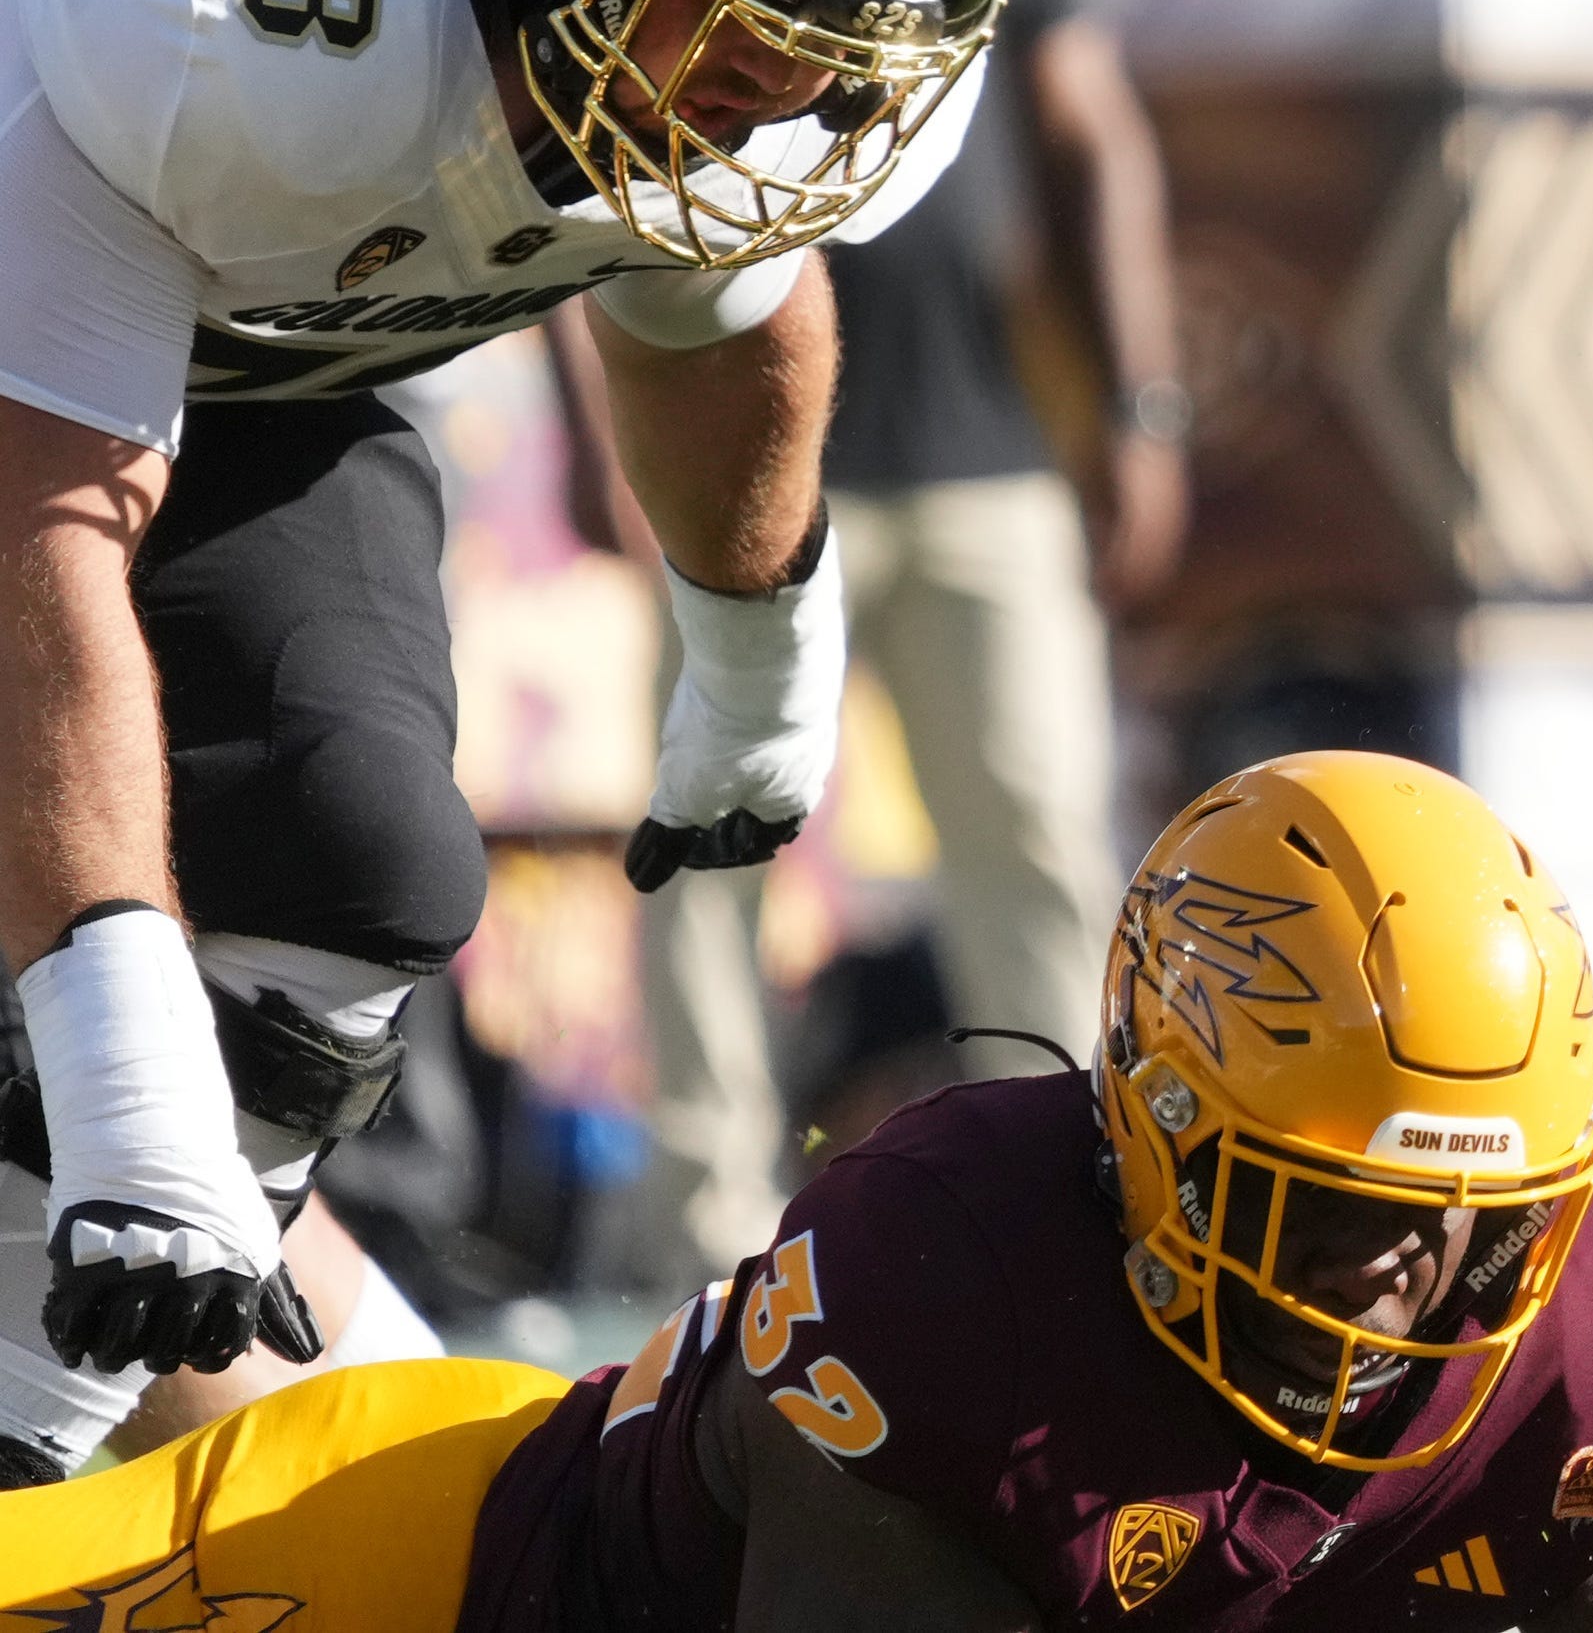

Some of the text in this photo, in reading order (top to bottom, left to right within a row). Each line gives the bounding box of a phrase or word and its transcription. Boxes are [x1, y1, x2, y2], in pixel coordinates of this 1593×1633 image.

[1400, 1128, 1510, 1154] SUN DEVILS
[1465, 1200, 1554, 1293] Riddell
[741, 1229, 888, 1458] 32
[1276, 1386, 1361, 1414] Riddll
[1113, 1510, 1195, 1574] PAC
[1119, 1550, 1165, 1590] 12
